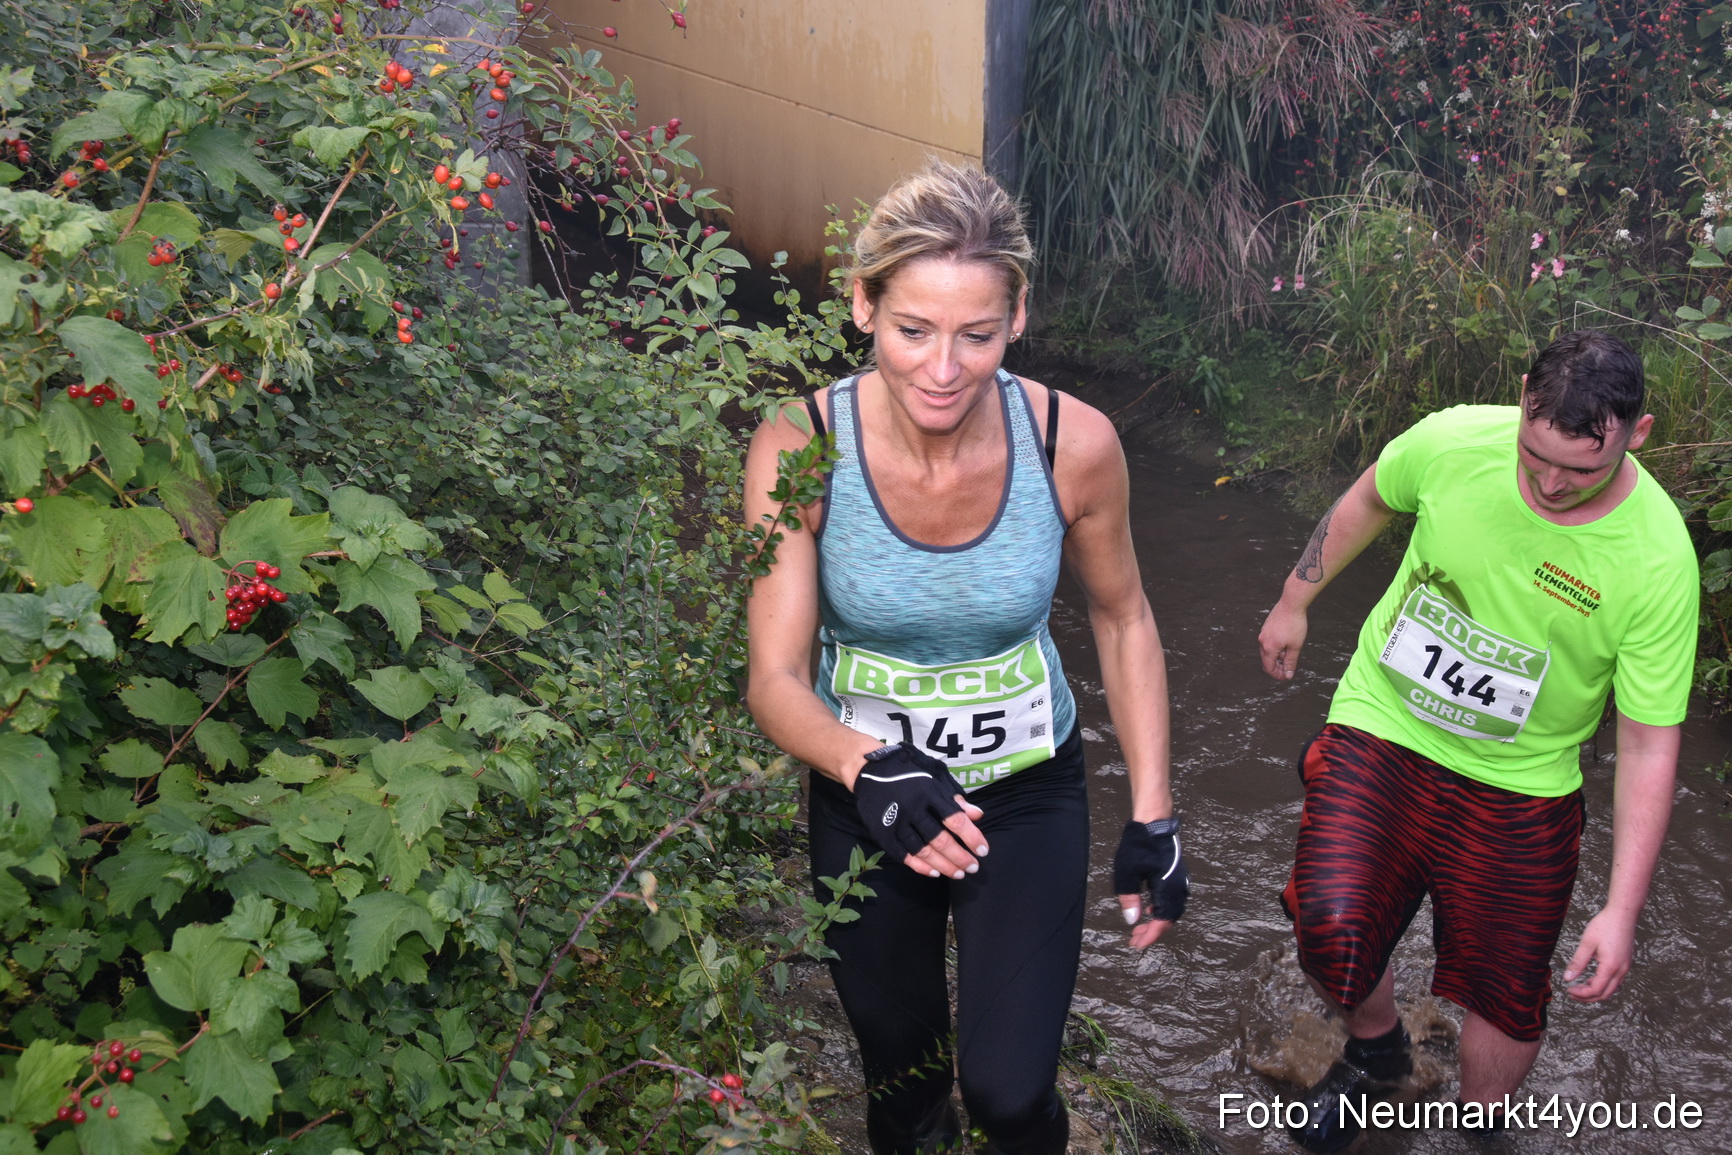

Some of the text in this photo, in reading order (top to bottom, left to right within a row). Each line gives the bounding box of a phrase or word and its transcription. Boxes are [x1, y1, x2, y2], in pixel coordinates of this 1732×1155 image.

[1534, 568, 1600, 611] ELEMENTELAUF
[1542, 561, 1601, 601] NEUMARKTER
[1542, 586, 1577, 609] September
[1416, 597, 1534, 673] BOCK
[850, 655, 1030, 699] BOCK
[1423, 645, 1496, 707] 144
[1519, 688, 1531, 697] E6
[1031, 698, 1044, 709] E6
[1409, 688, 1477, 726] CHRIS
[887, 710, 1006, 758] 145
[949, 761, 1011, 785] NNE
